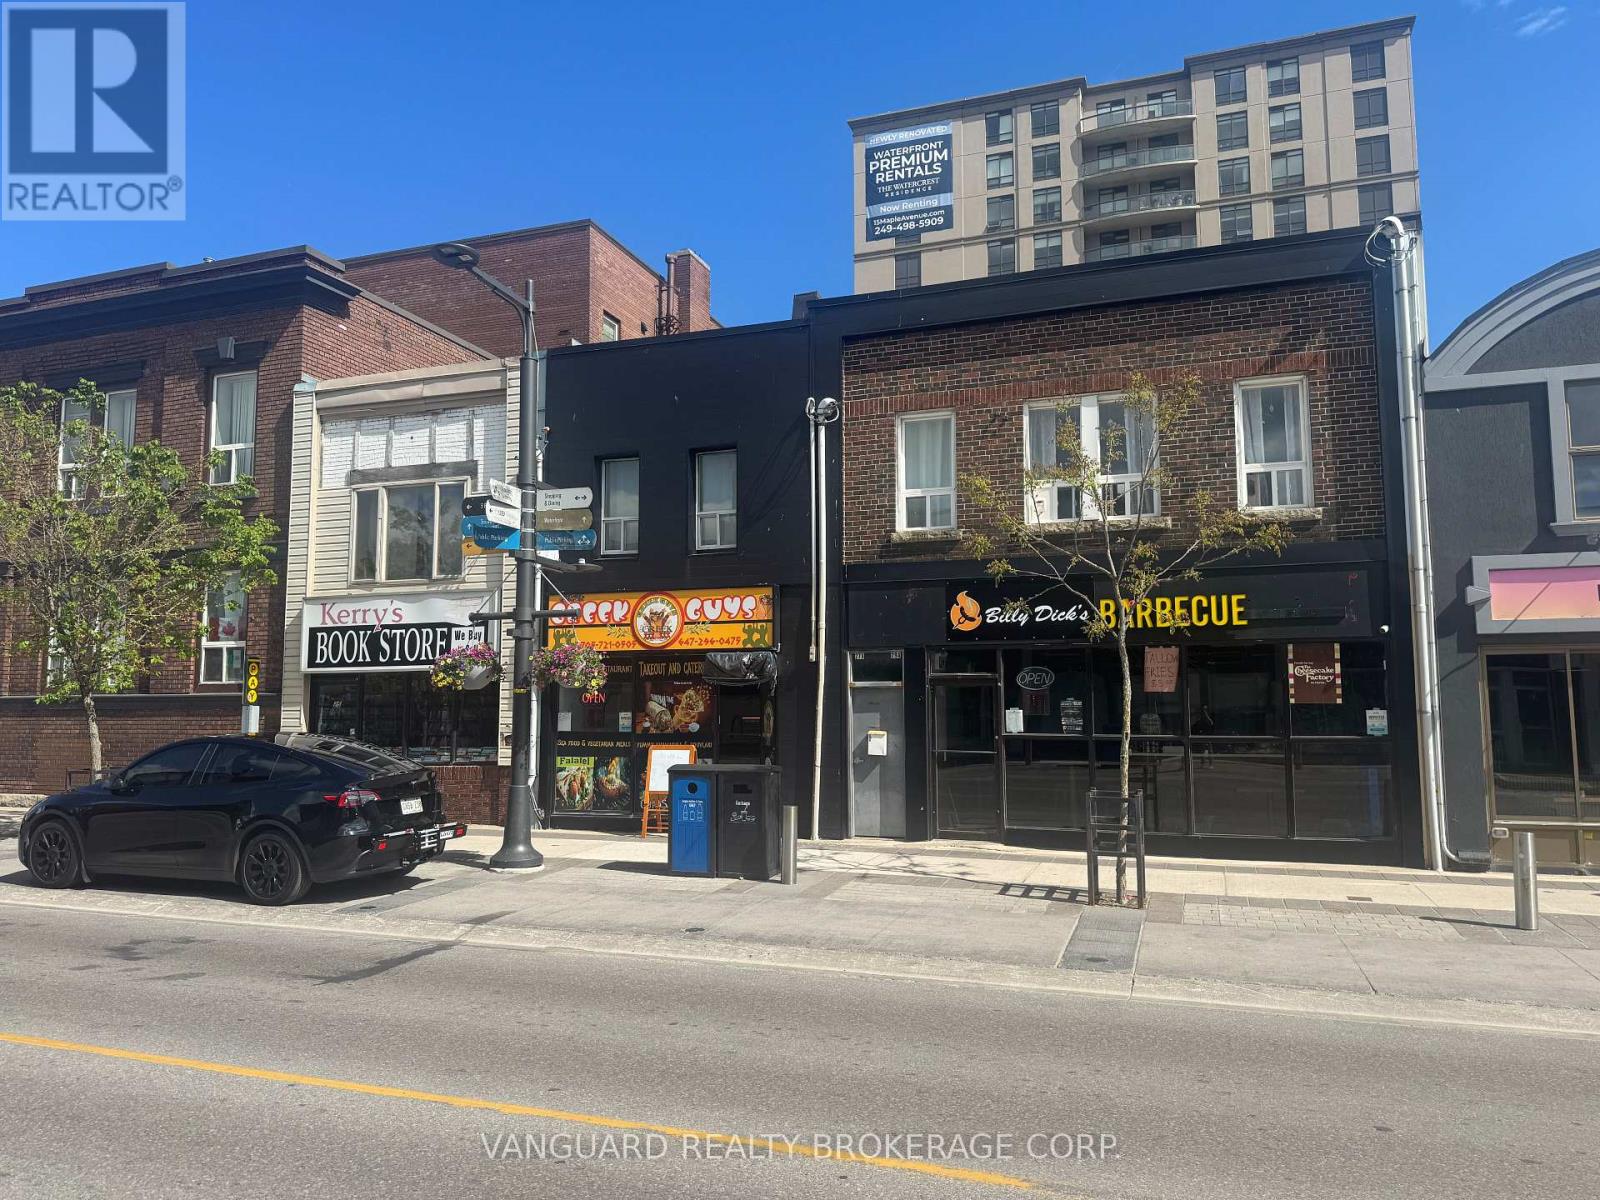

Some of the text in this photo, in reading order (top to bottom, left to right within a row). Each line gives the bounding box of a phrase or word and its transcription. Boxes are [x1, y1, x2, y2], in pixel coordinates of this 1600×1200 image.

[870, 125, 948, 144] NEWLY RENOVATED
[873, 141, 944, 159] WATERFRONT
[869, 149, 948, 173] PREMIUM
[876, 163, 942, 183] RENTALS
[877, 177, 940, 193] THE WATERCREST
[885, 186, 932, 197] RESIDENCE
[880, 198, 938, 213] Now Renting
[874, 216, 944, 235] 249-498-5909
[320, 600, 403, 632] Kerry's
[685, 595, 756, 620] GUYS
[985, 593, 1248, 629] Billy Dick's BARBECUE
[454, 630, 482, 641] We Buy
[315, 629, 371, 664] BOOK
[638, 661, 667, 676] TAKEOUT
[668, 661, 682, 676] AND
[1019, 672, 1051, 684] OPEN
[1306, 673, 1334, 683] Factory
